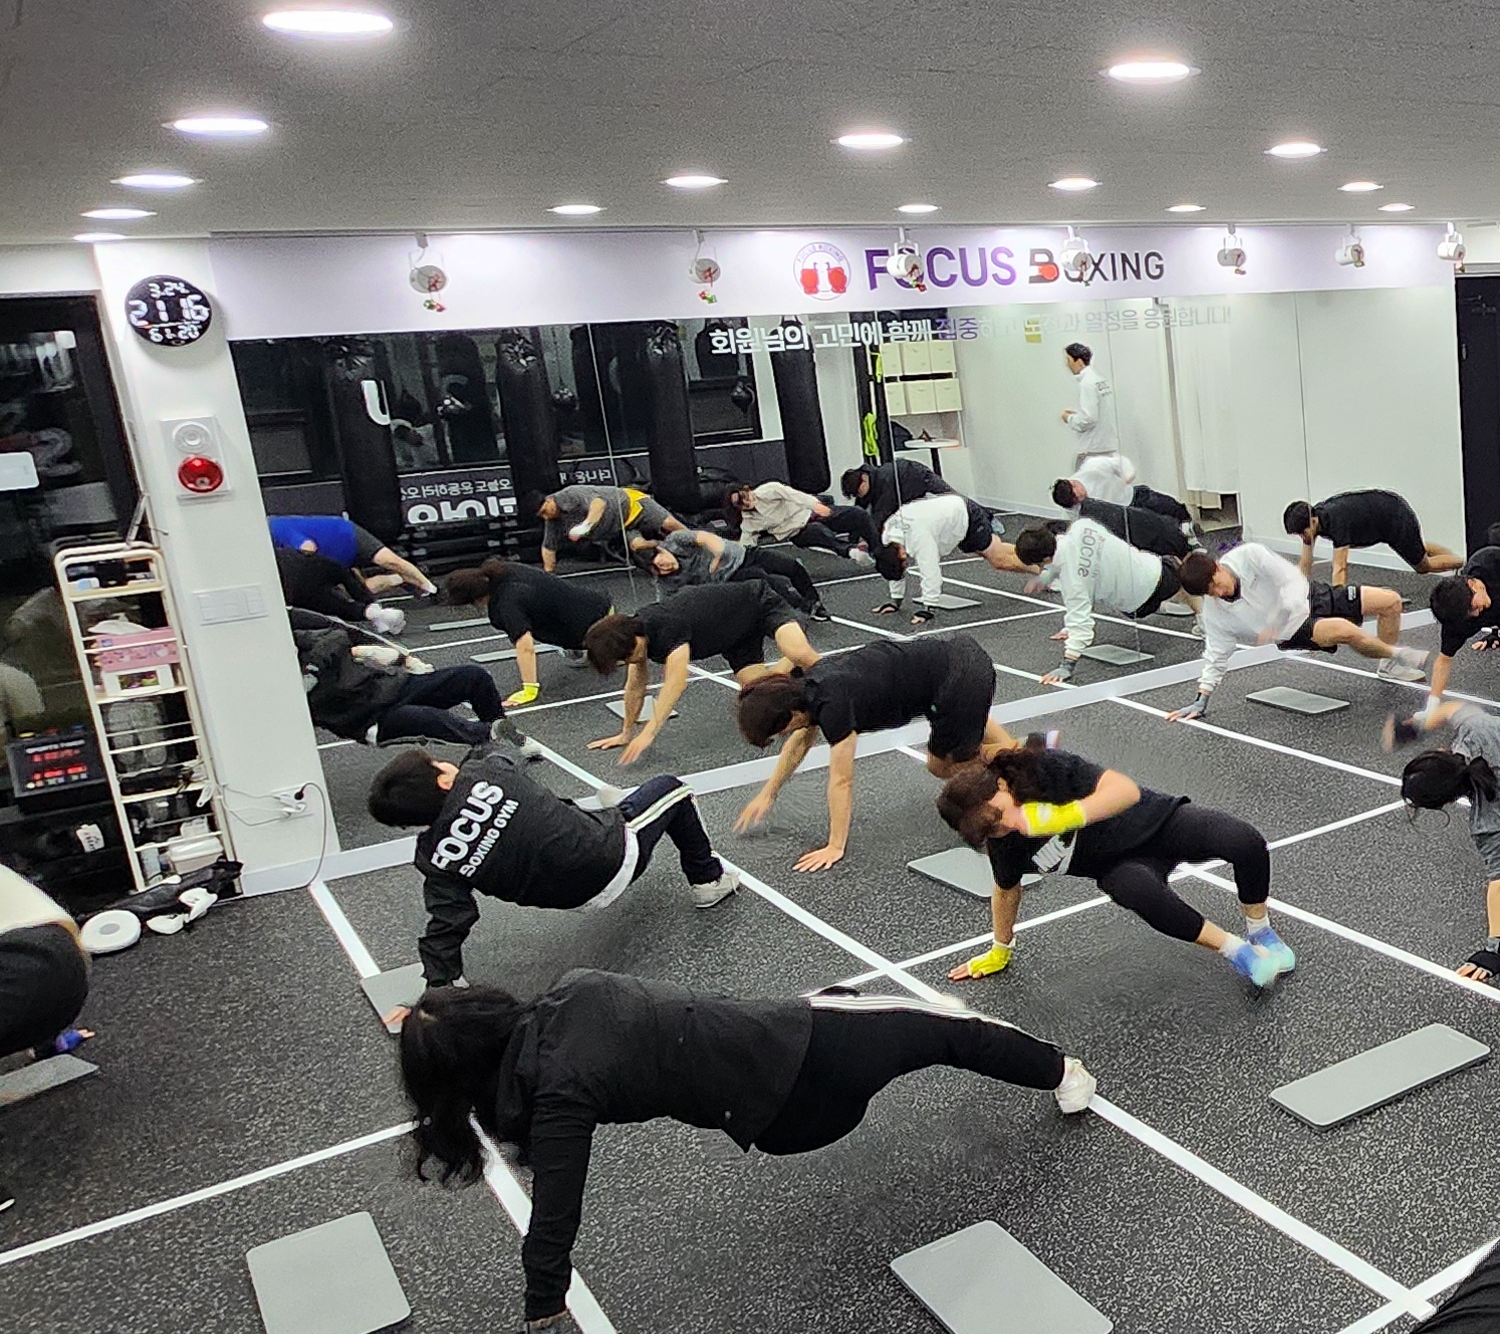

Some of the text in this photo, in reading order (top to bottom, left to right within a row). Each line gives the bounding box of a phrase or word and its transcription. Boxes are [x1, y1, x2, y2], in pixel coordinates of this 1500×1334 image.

[708, 325, 811, 356] 회원님의
[814, 321, 883, 350] 고민에
[887, 318, 932, 344] 함께
[1085, 309, 1139, 331] 열정을
[430, 780, 504, 871] FOCUS
[459, 799, 520, 878] BOXING GYM
